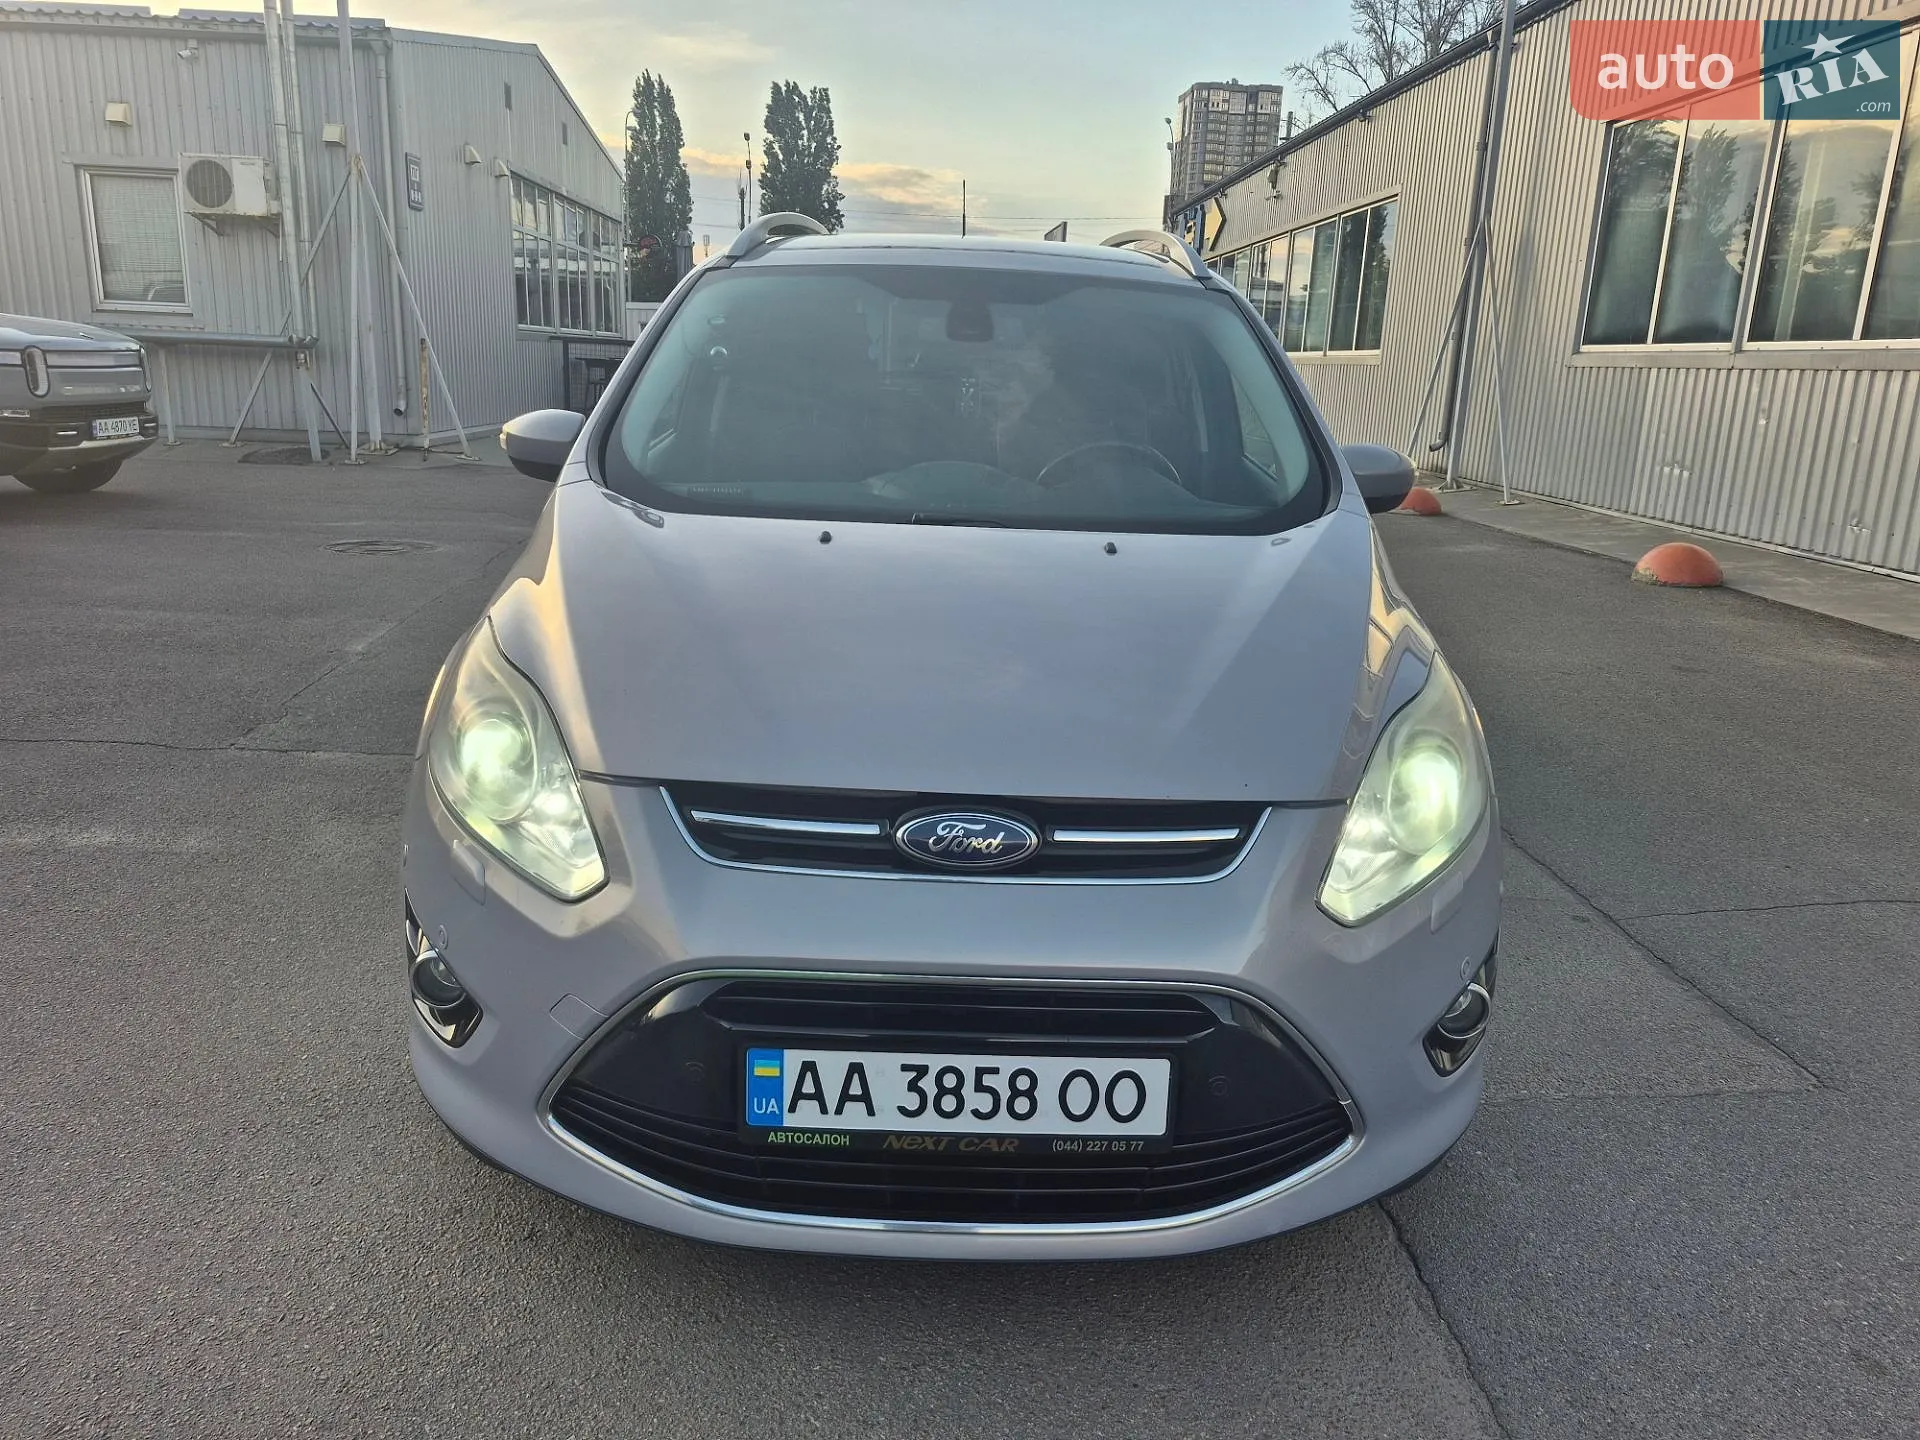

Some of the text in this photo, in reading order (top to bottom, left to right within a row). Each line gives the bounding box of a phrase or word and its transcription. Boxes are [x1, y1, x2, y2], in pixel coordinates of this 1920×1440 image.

[928, 821, 1005, 854] Ford
[787, 1060, 1147, 1123] AA 3858 OO
[753, 1097, 780, 1115] UA
[767, 1131, 850, 1146] АВТОСАЛОН
[958, 1136, 1020, 1152] CAR
[1052, 1138, 1144, 1152] (044) 227 05 77
